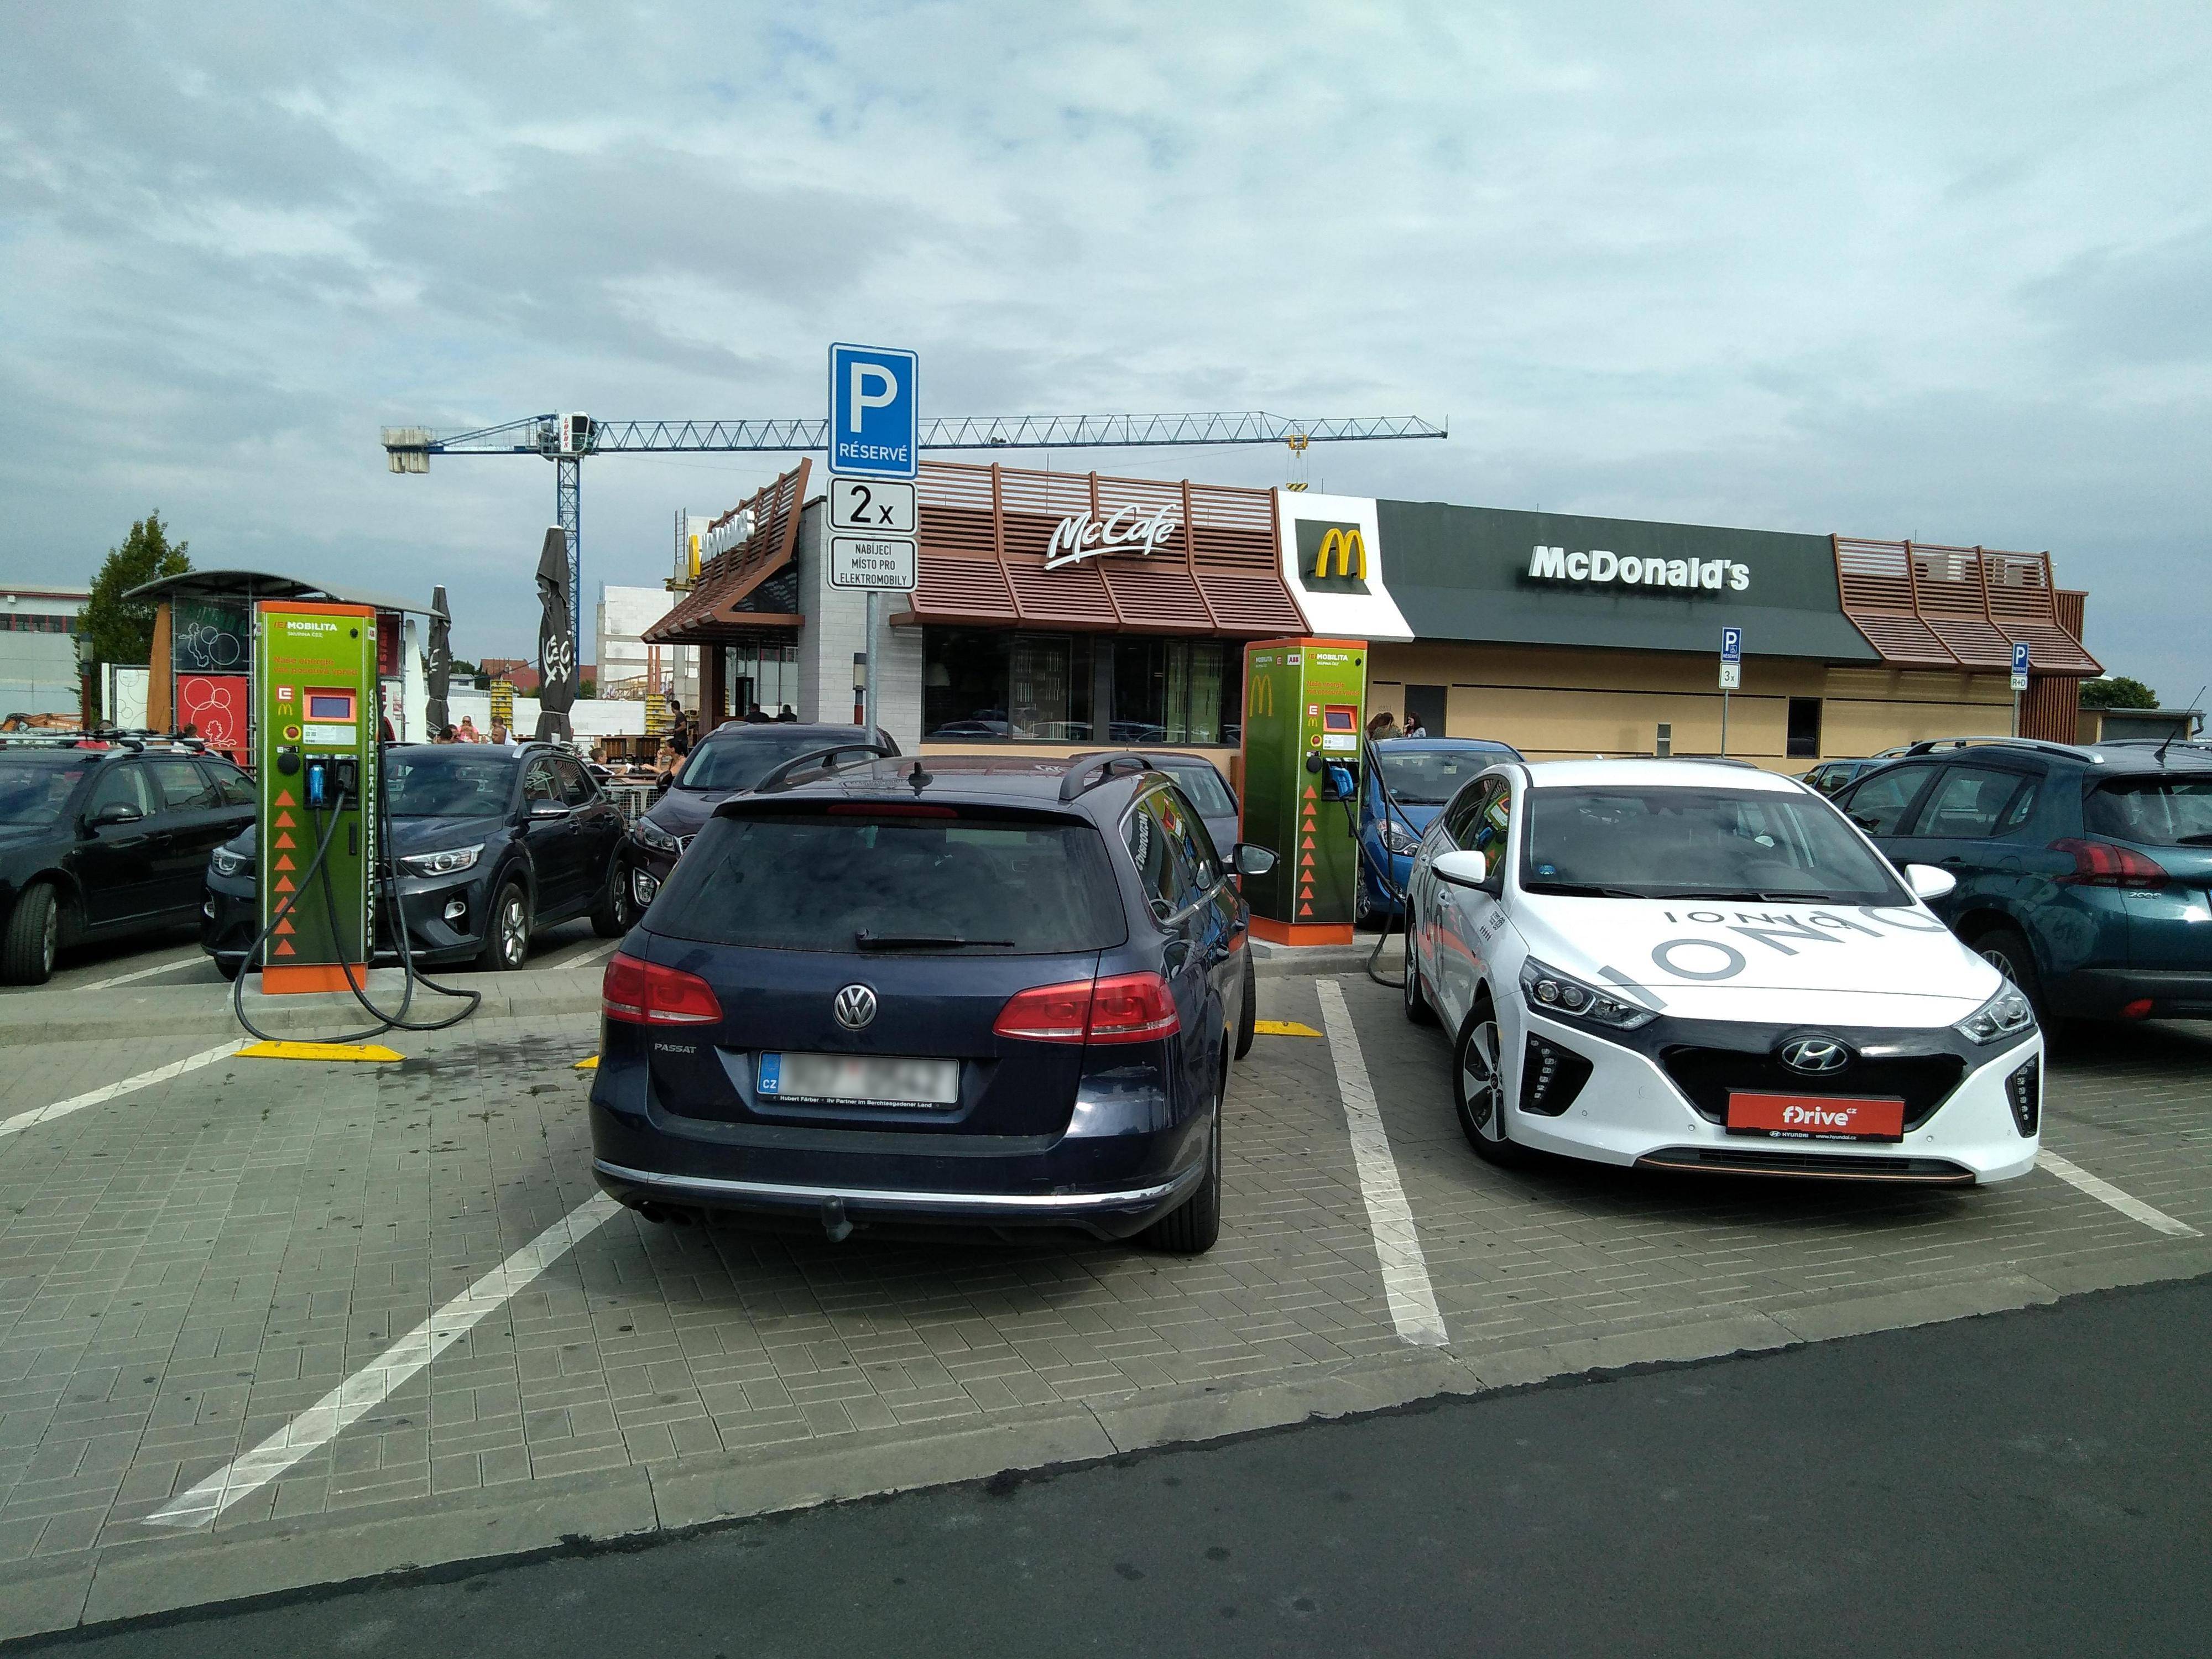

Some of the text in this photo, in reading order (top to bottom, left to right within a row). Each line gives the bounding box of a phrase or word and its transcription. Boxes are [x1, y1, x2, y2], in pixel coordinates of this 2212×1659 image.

[851, 362, 898, 433] P
[839, 441, 907, 462] RÉSERVÉ
[855, 542, 891, 555] NABÍJECÍ
[852, 557, 895, 571] MÍSTO PRO
[1528, 545, 1750, 591] McDonald's
[840, 573, 907, 586] ELEKTROMOBILY
[1725, 632, 1737, 651] P
[2016, 646, 2026, 665] P
[1724, 670, 1735, 682] 3x
[1663, 910, 1853, 930] IONIQ
[654, 1043, 697, 1053] PASSAT
[762, 1079, 777, 1089] CZ
[867, 1099, 916, 1108] Berchtesgadener
